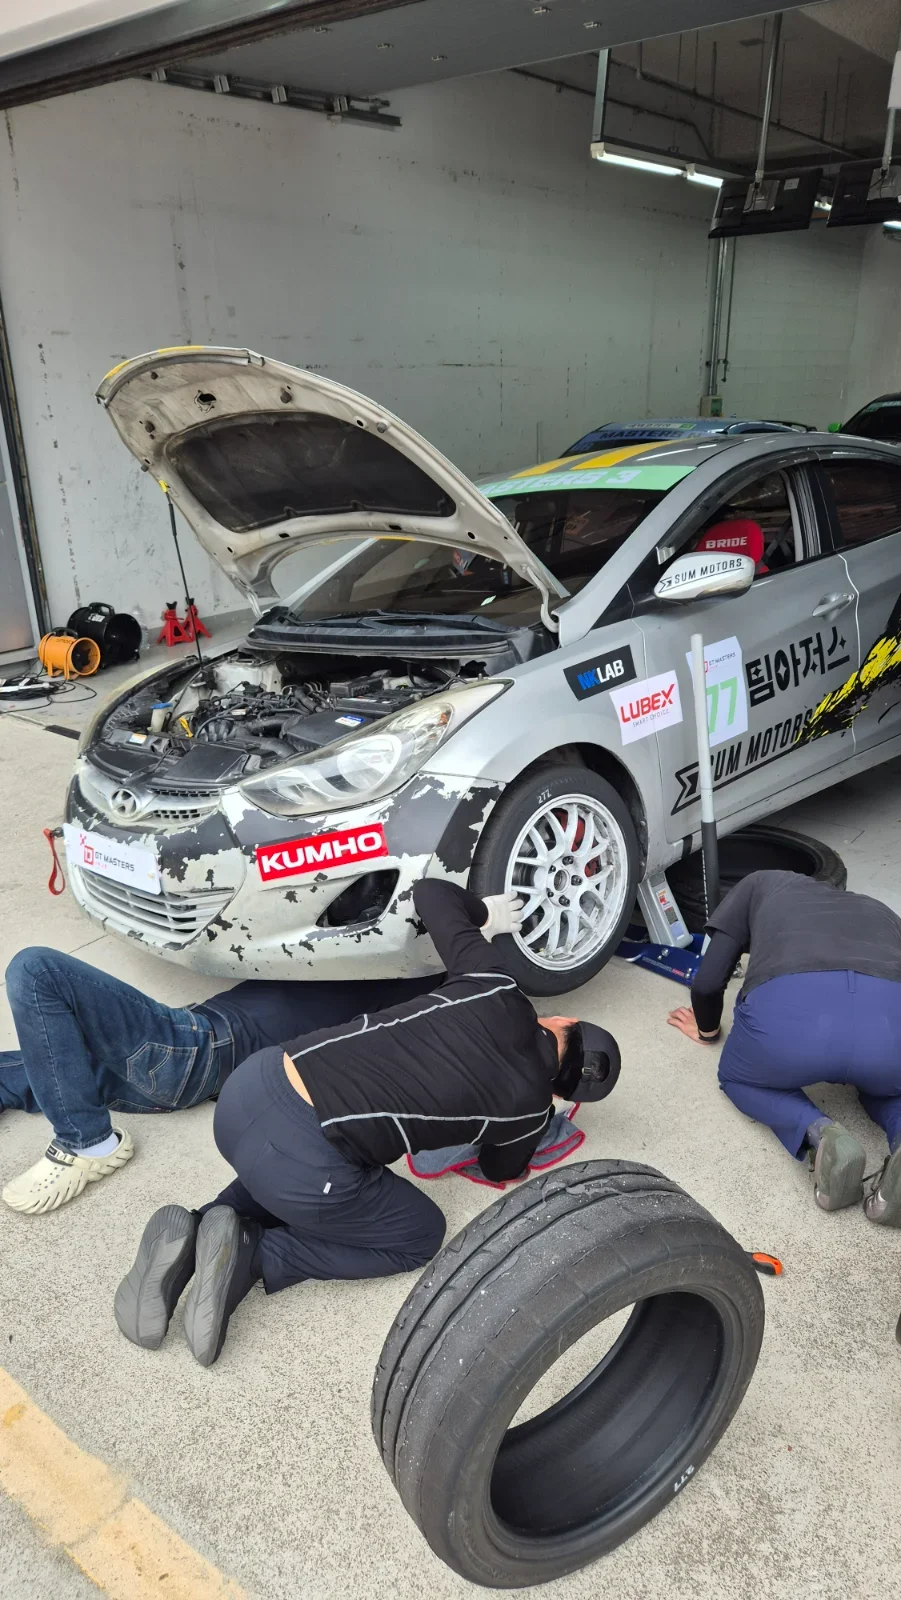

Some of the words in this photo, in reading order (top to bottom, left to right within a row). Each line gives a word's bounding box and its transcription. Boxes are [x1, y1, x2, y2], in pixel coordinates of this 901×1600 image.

[479, 470, 608, 495] ASTERS
[605, 469, 642, 485] 3
[705, 536, 748, 549] BRIDE
[674, 568, 697, 584] SUM
[700, 558, 742, 576] MOTORS
[620, 683, 675, 723] LUBEX
[650, 708, 670, 720] CHOICE
[710, 742, 743, 782] UM
[103, 854, 135, 872] MASTERS
[261, 831, 382, 874] KUMHO
